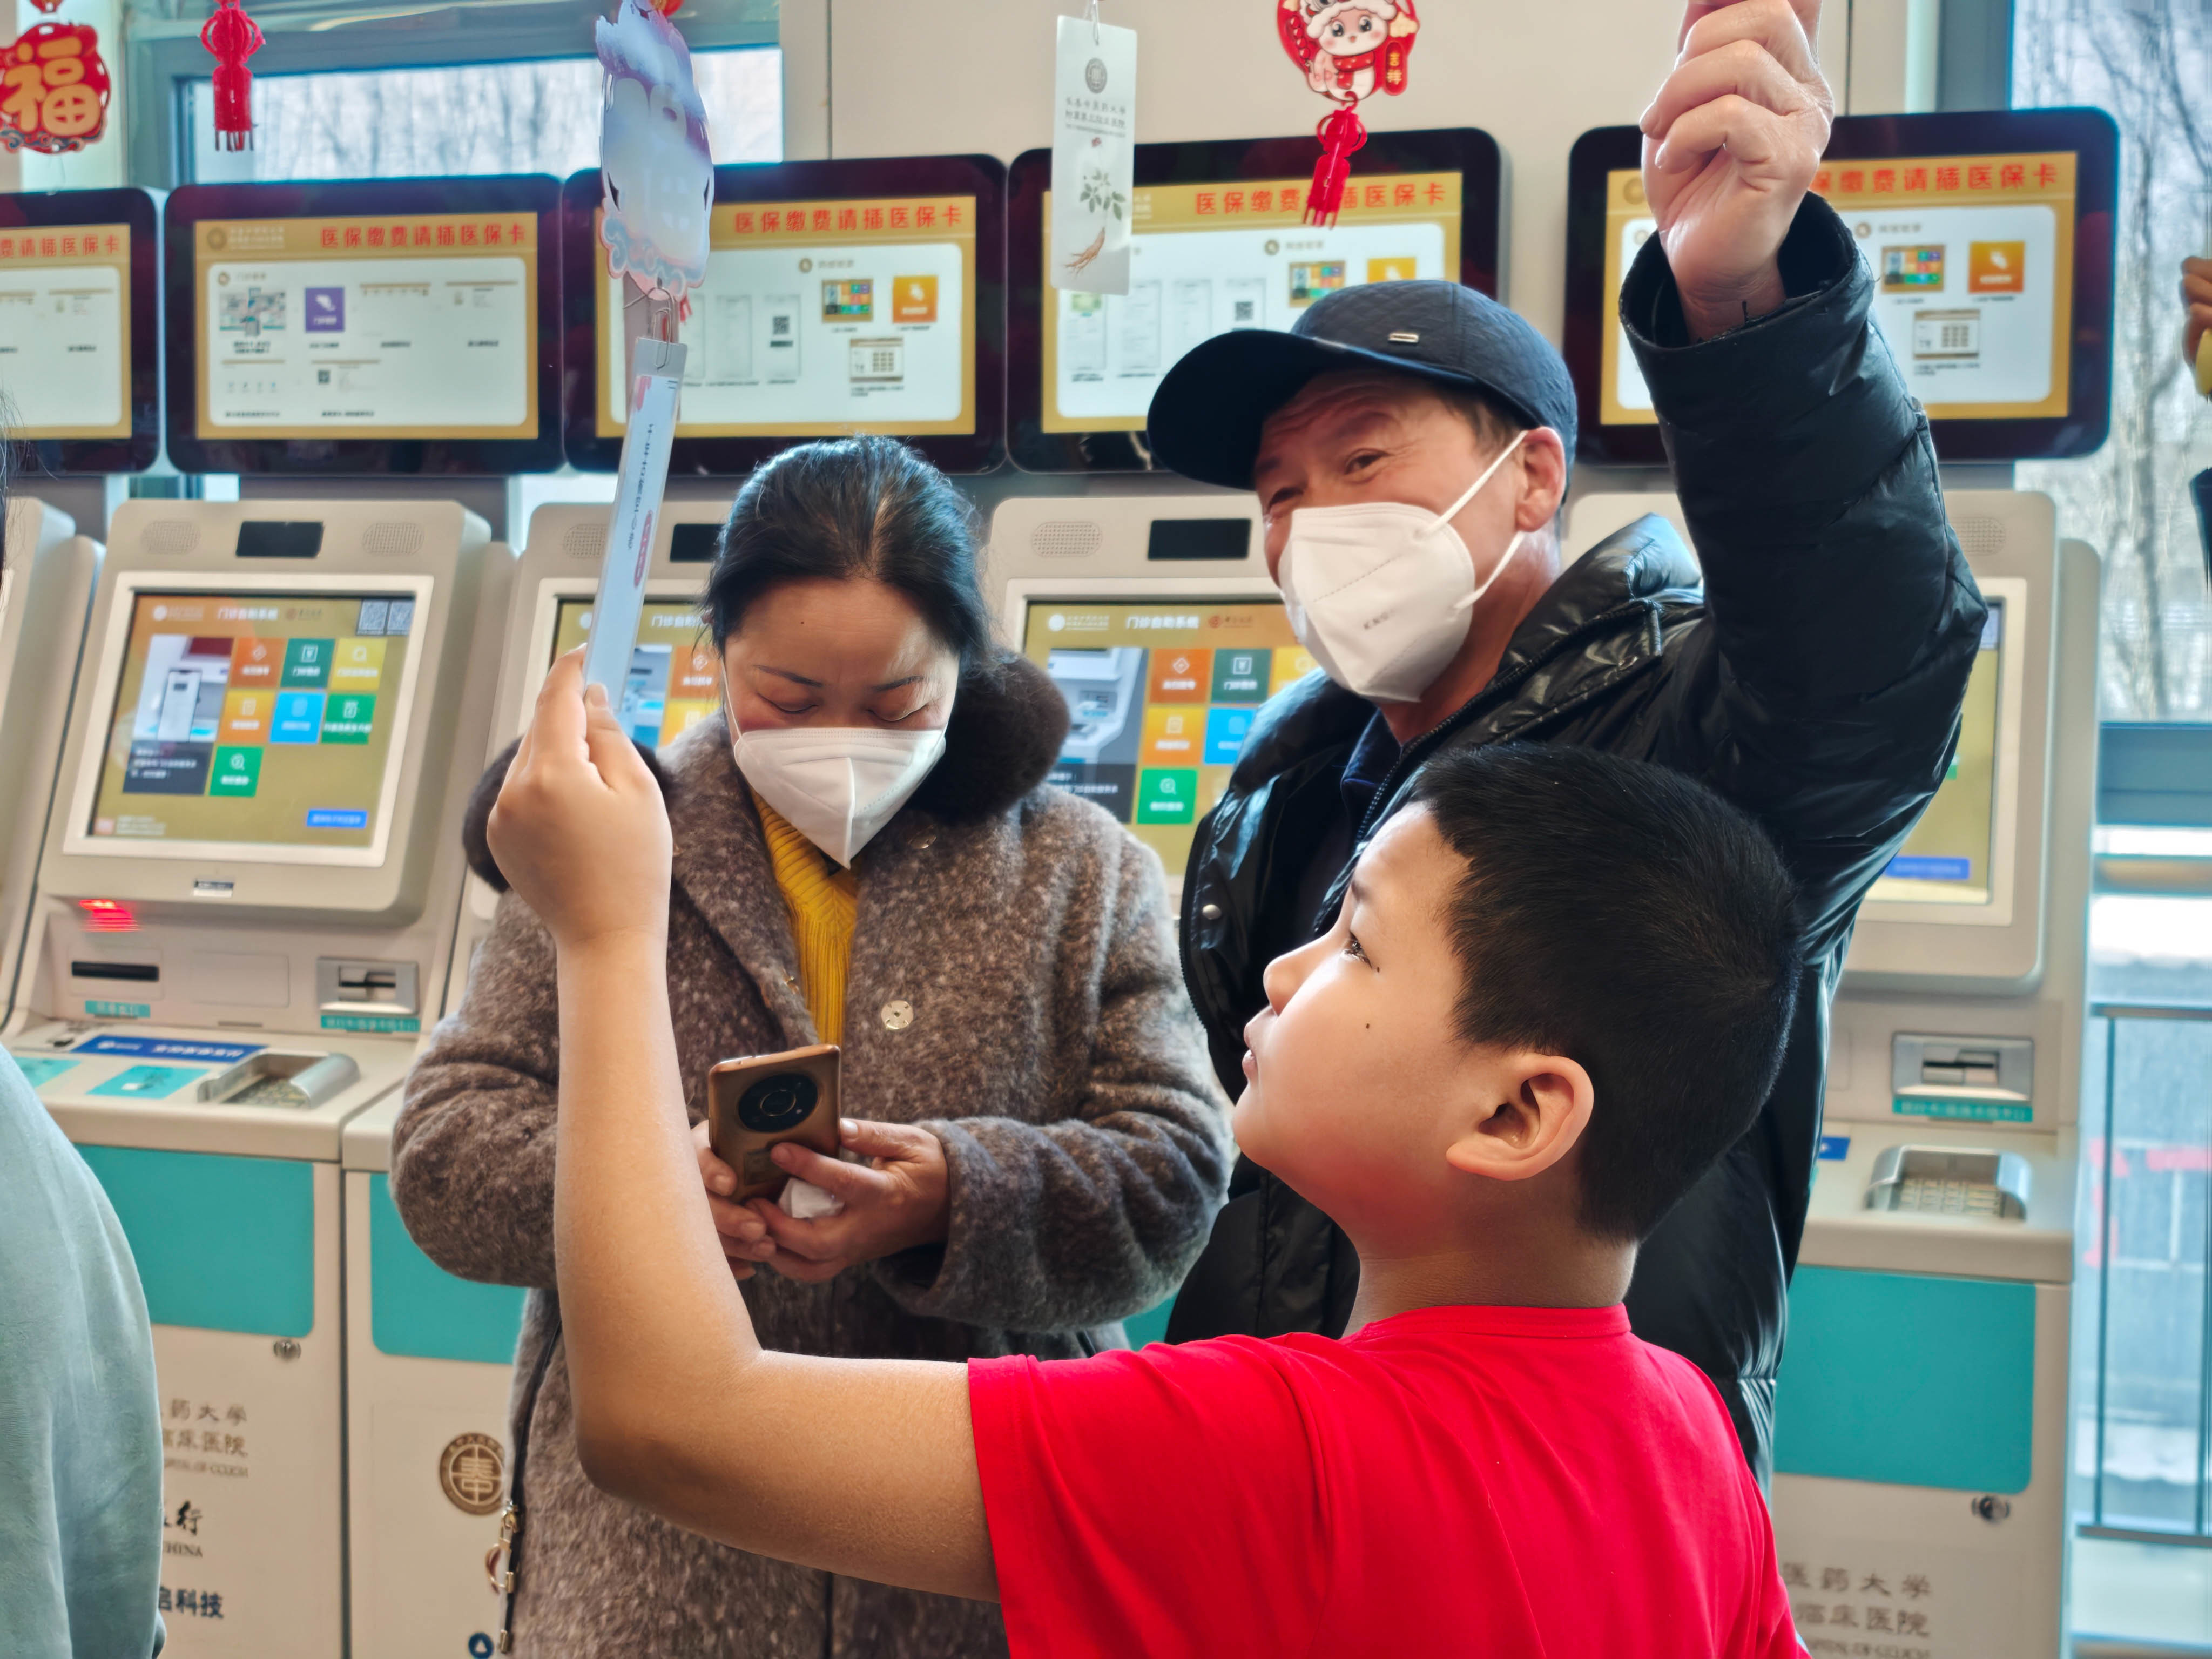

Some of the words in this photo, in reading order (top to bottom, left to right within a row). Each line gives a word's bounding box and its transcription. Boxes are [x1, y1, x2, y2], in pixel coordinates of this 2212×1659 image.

[3, 37, 102, 136] 福
[1195, 183, 1446, 215] 医保缴费插医保卡
[735, 205, 963, 234] 医保缴费请插医保卡
[321, 222, 526, 248] 医保缴费请插医保卡
[160, 1398, 247, 1426] 药大学
